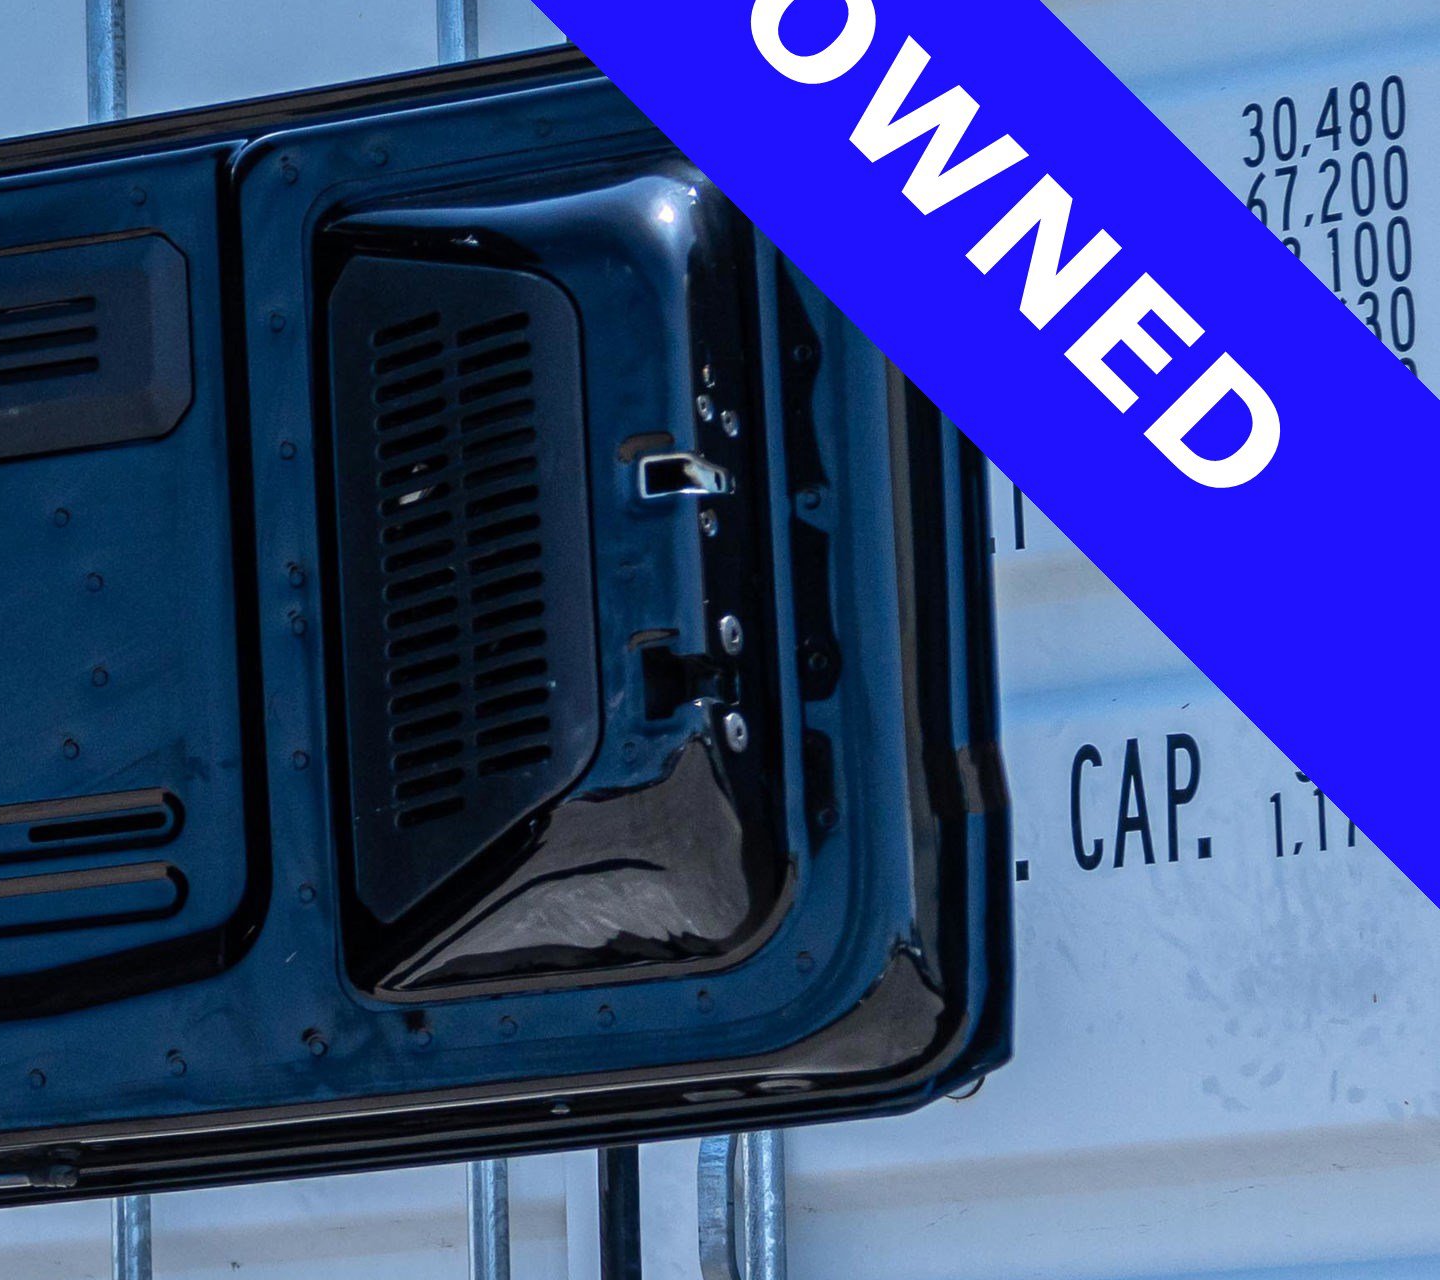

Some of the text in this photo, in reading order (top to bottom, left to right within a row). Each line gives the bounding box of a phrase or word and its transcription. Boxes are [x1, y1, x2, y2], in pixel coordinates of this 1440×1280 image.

[1242, 75, 1406, 168] 30,480
[1246, 145, 1409, 232] 67,200
[1070, 733, 1212, 871] CAP.
